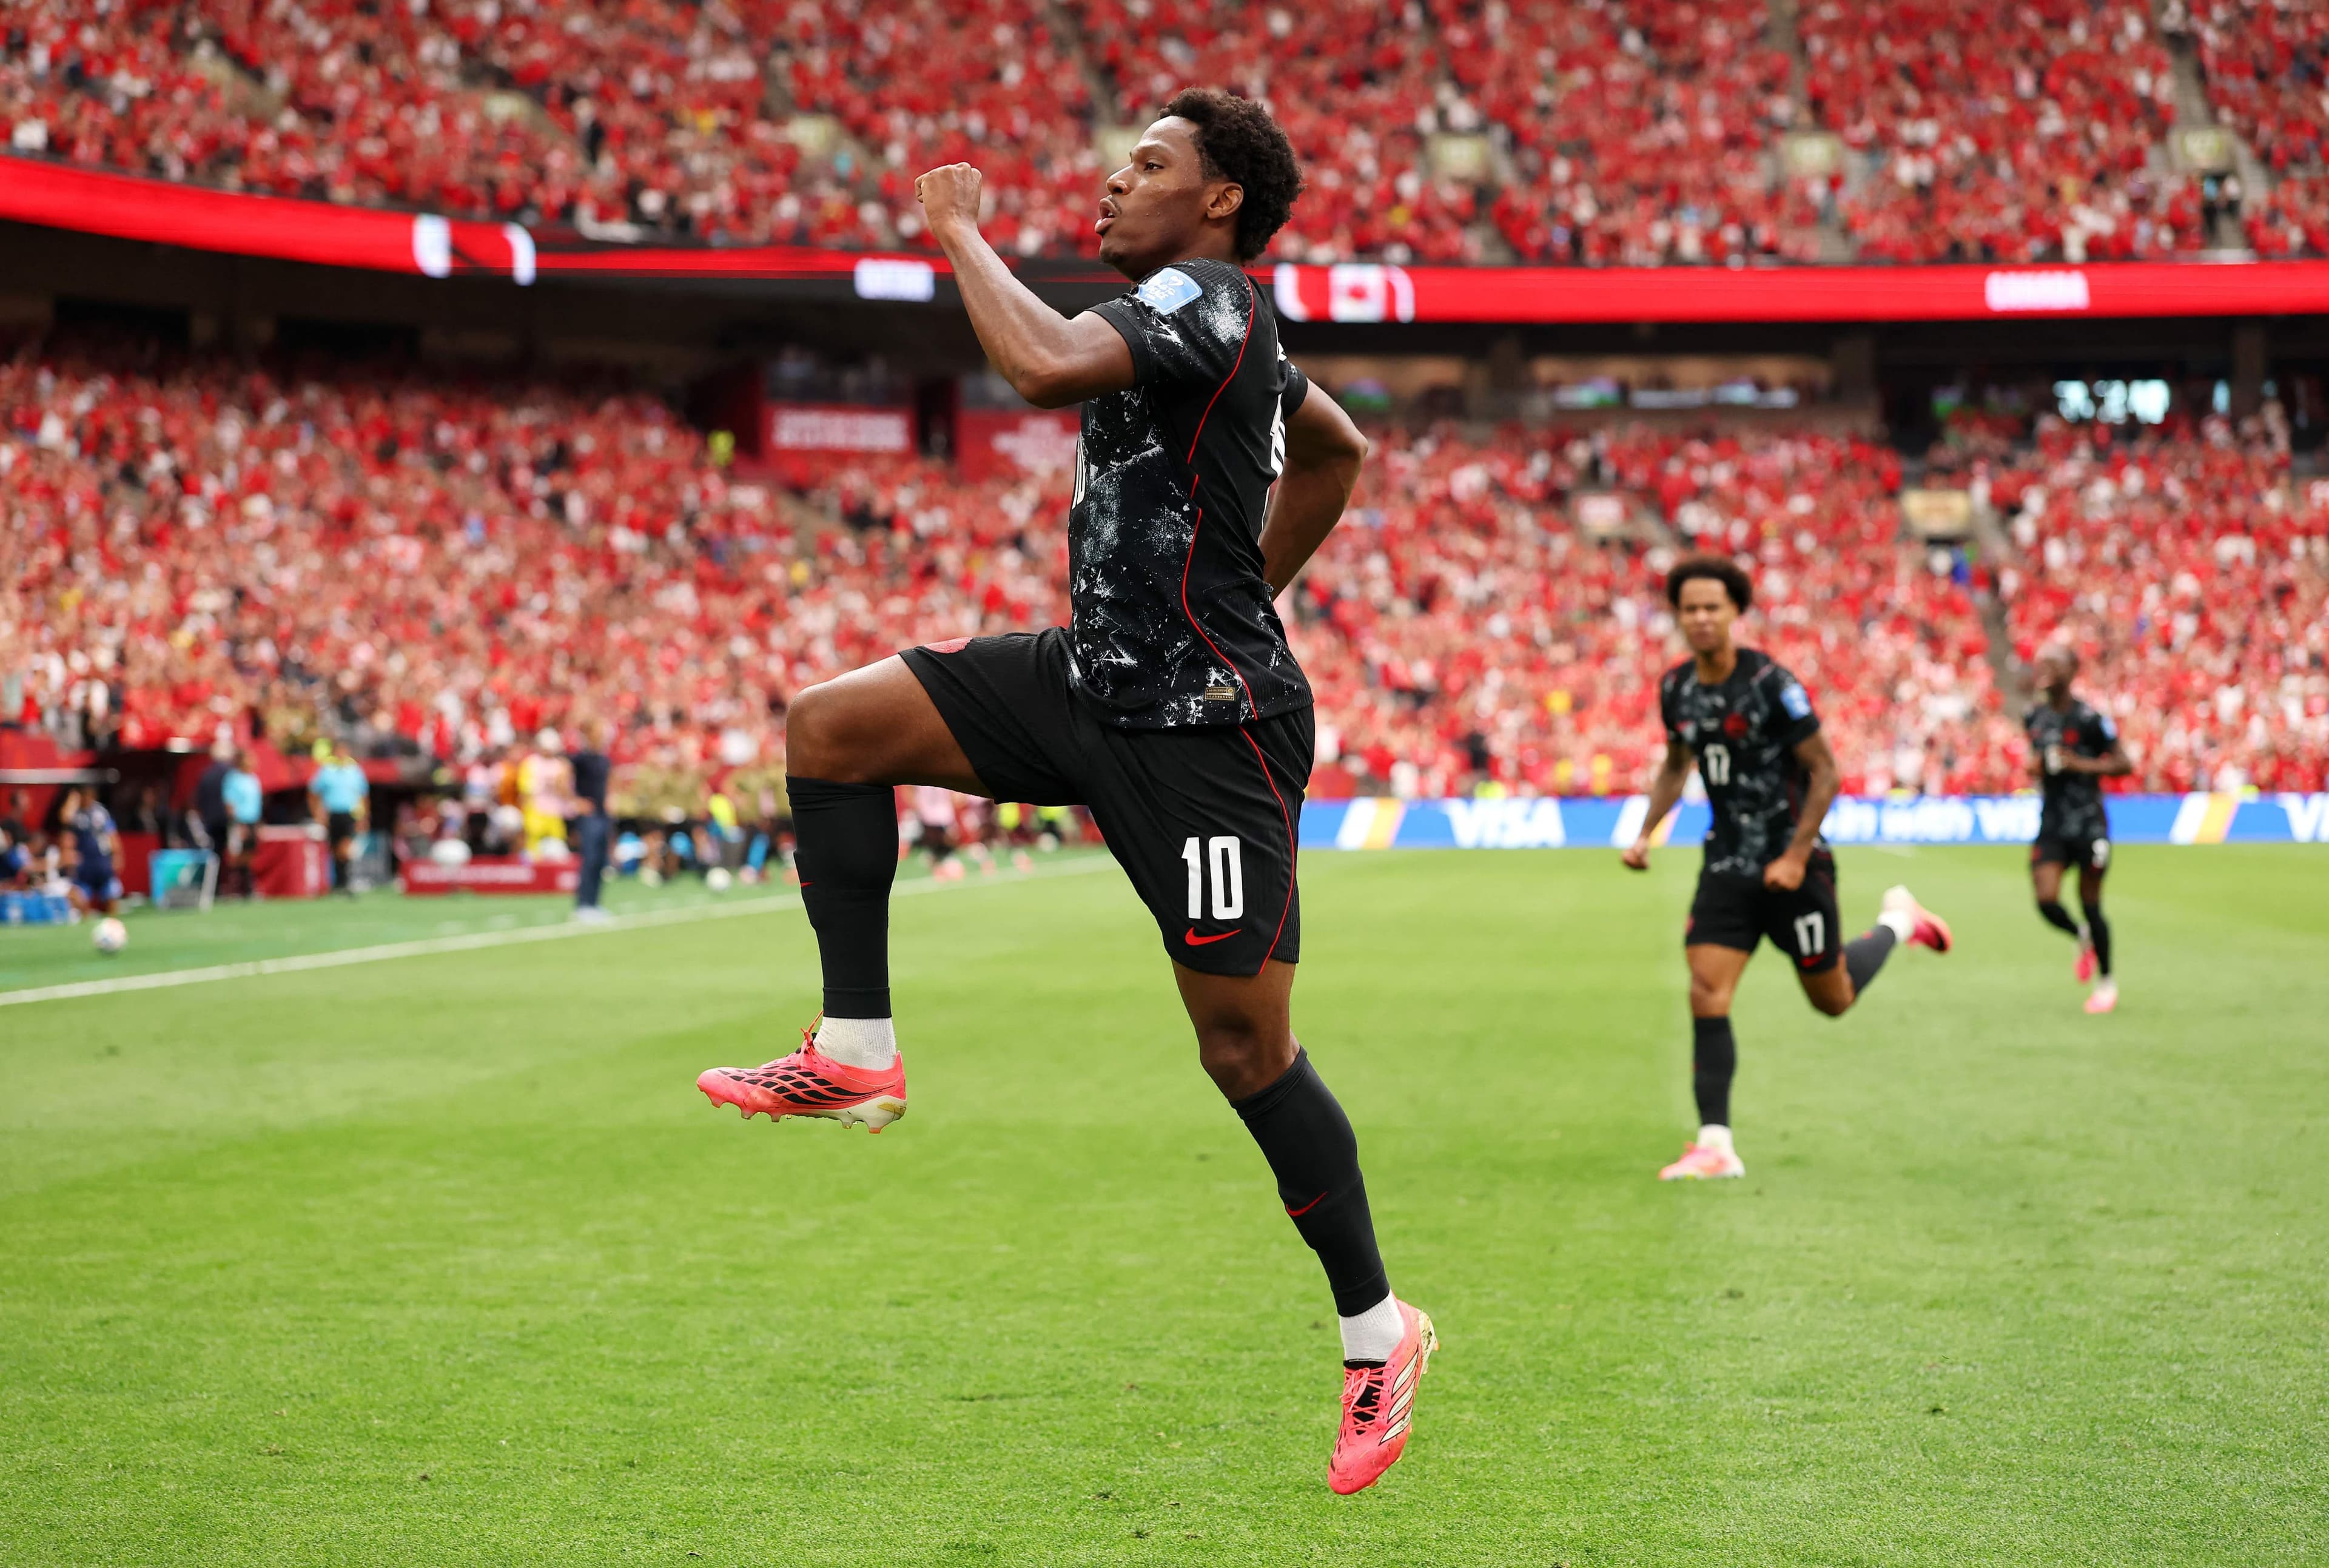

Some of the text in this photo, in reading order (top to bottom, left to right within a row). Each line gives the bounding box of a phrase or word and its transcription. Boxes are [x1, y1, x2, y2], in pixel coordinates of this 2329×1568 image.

[1703, 743, 1731, 786] 17
[1442, 797, 1567, 847] VISA
[1181, 836, 1243, 920] 10
[1793, 911, 1825, 956] 17
